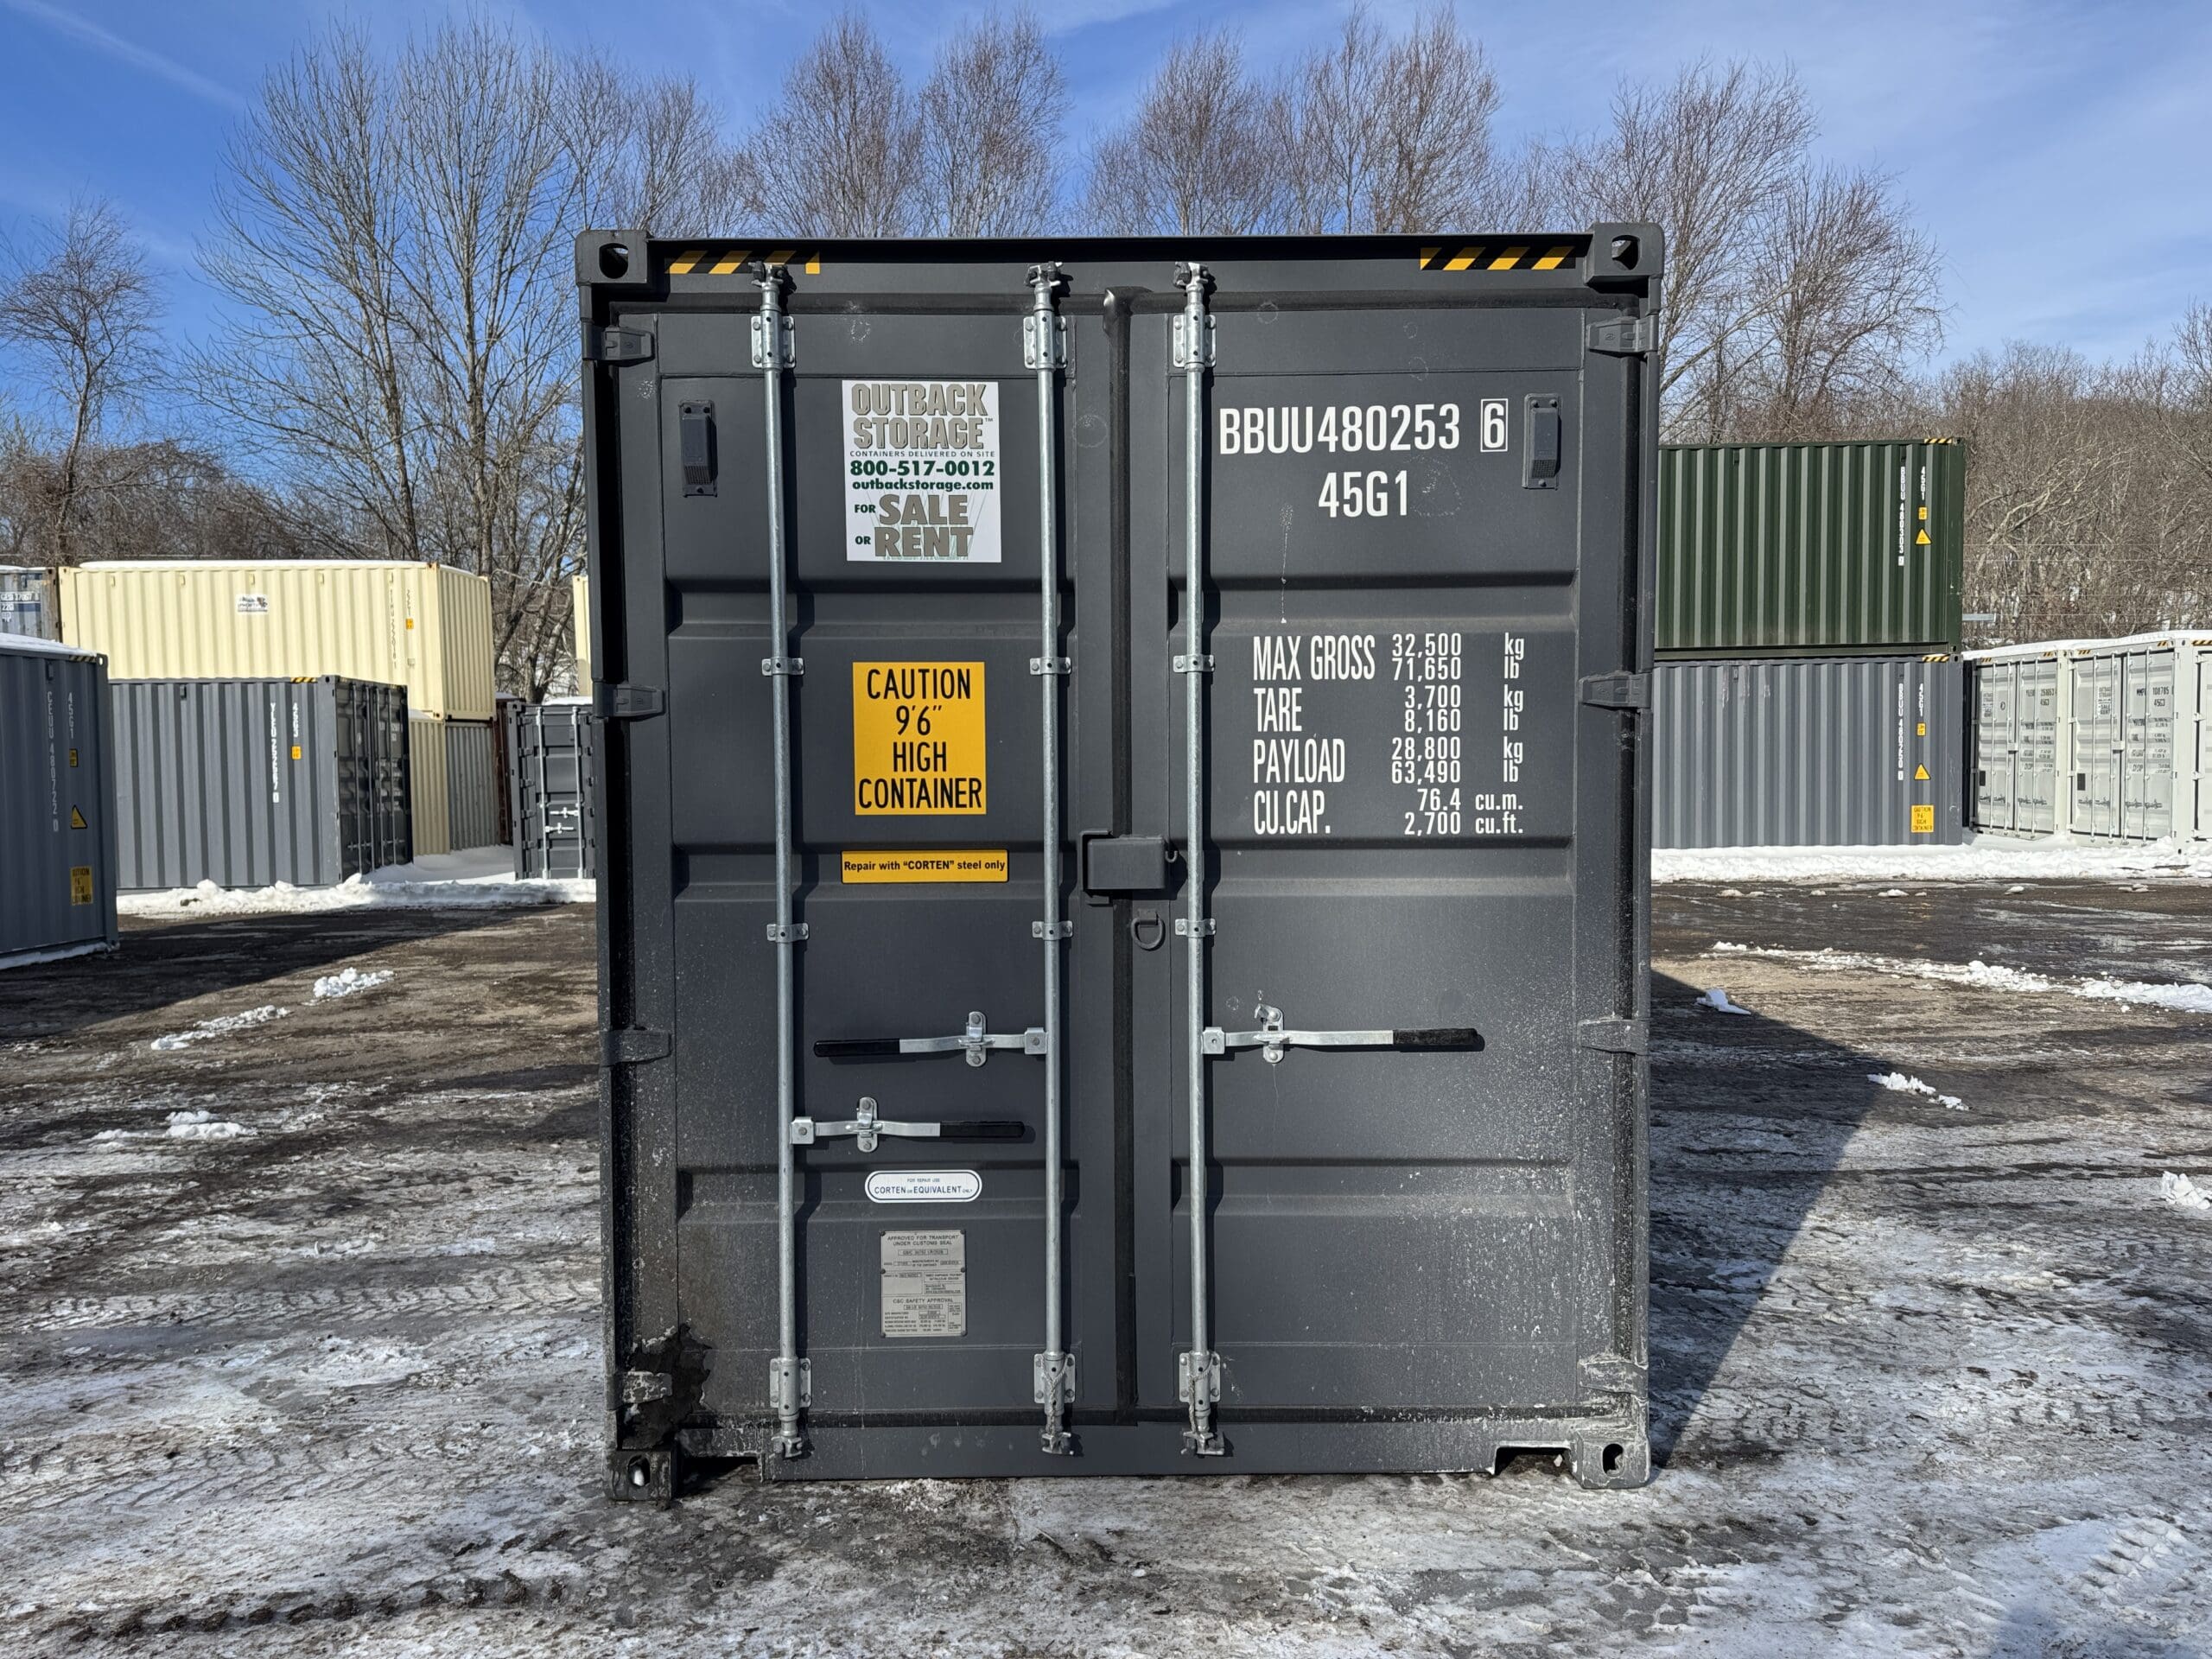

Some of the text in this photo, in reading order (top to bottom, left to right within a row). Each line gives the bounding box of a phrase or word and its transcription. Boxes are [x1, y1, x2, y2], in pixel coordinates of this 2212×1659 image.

[851, 384, 988, 416] OUTBACK
[853, 416, 984, 449] STORAGE
[1220, 402, 1506, 454] BBUU480253 6
[850, 461, 995, 476] 800-517-0012
[852, 478, 994, 492] outbackstorage.com
[1318, 470, 1408, 518] 45G1
[854, 494, 969, 525] FOR SALE
[855, 527, 974, 557] OR RENT
[1254, 632, 1524, 681] MAX GROSS 32,500 kg
[1392, 656, 1520, 682] 71,650 lb
[867, 668, 970, 700] CAUTION
[1254, 684, 1523, 732] TARE 3,700 kg
[1404, 708, 1519, 734] 8,160 lb
[893, 741, 947, 772] HIGH
[1254, 736, 1523, 784] PAYLOAD 28,800 kg
[1391, 760, 1519, 785] 63,490 lb
[858, 778, 982, 809] CONTAINER
[1417, 788, 1461, 811] 76.4
[1475, 792, 1523, 810] cu.m.
[1404, 810, 1523, 836] 2,700 cu.ft.
[843, 861, 875, 872] Repair
[879, 861, 900, 870] with
[957, 860, 982, 870] steel
[984, 860, 1006, 872] only
[874, 1185, 906, 1194] CORTEN
[913, 1185, 962, 1194] EQUIVALENT
